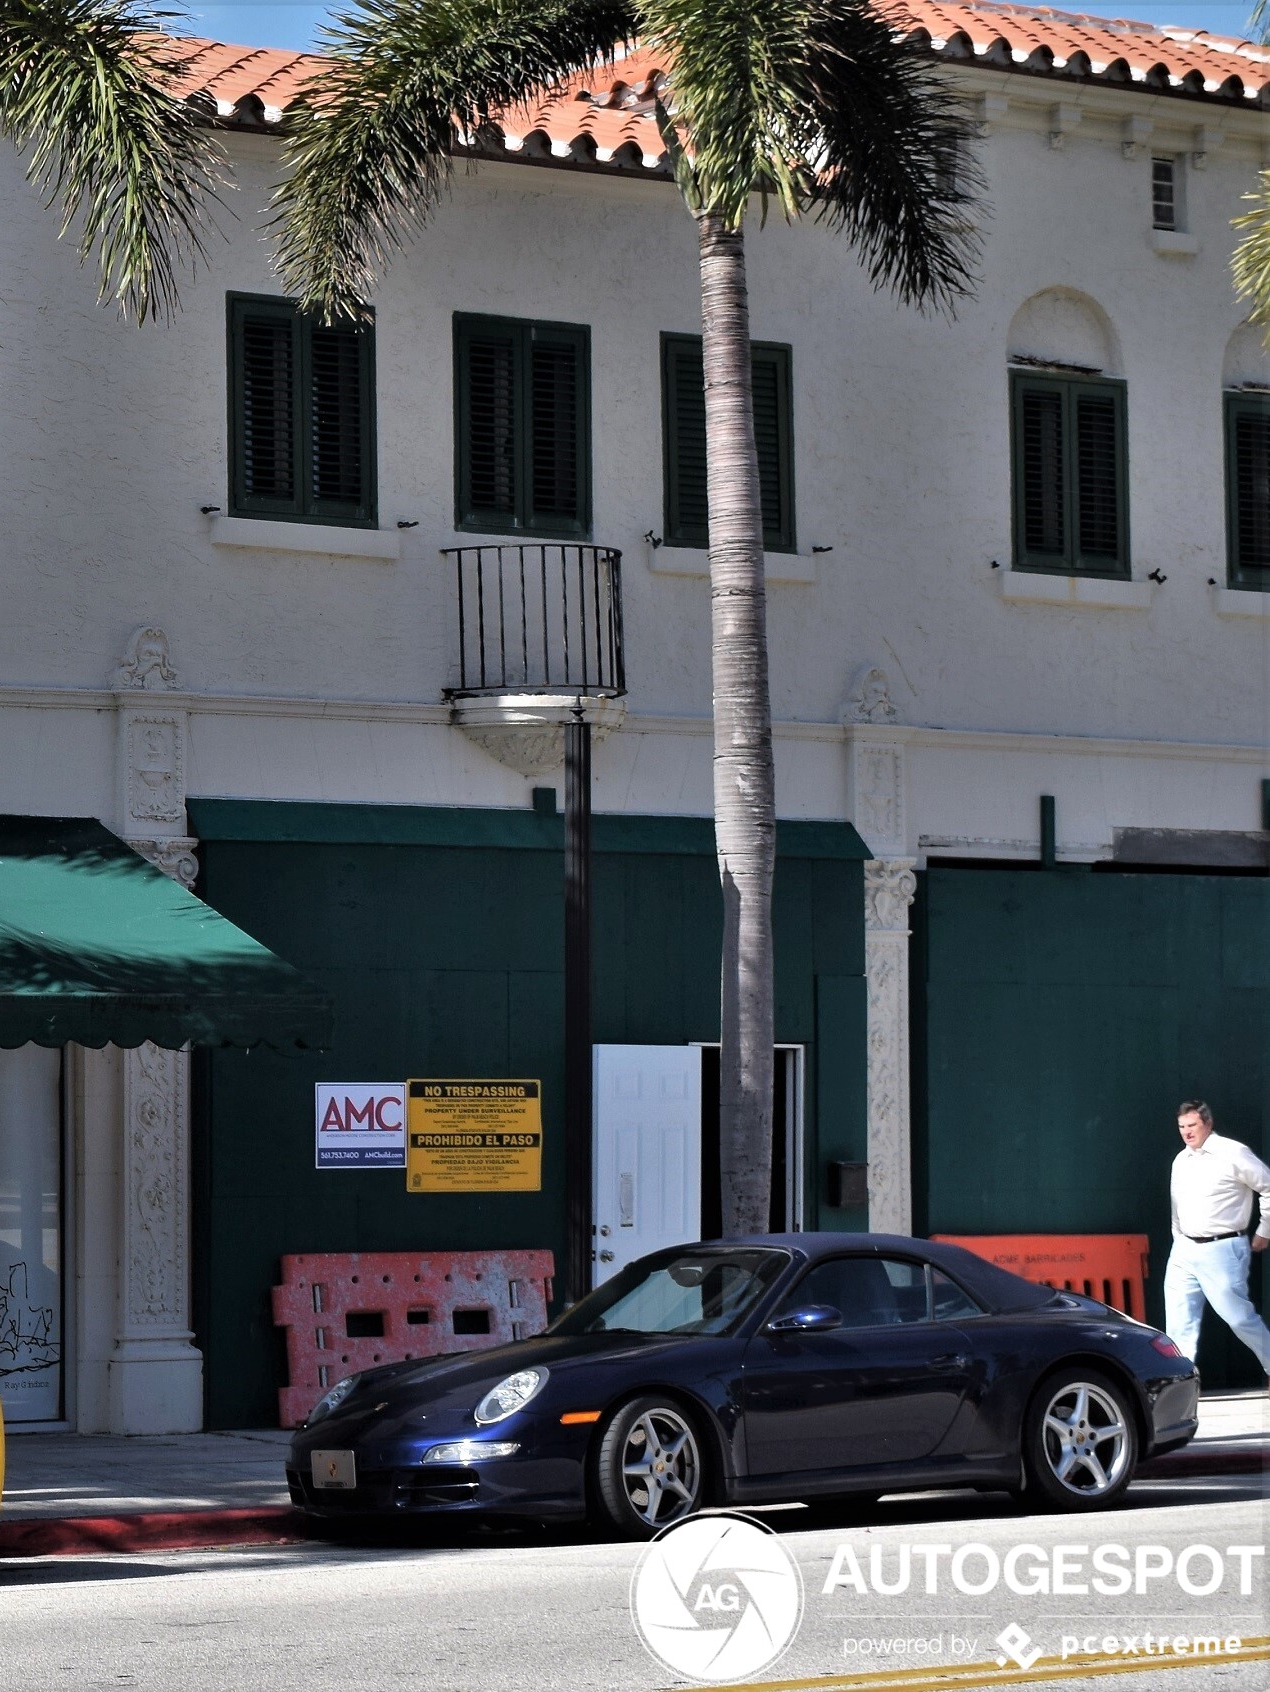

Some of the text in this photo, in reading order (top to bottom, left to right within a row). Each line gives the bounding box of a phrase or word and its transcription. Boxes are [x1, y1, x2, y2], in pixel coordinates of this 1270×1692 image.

[424, 1086, 526, 1097] NO TRESPASSING
[320, 1096, 403, 1131] AMC
[417, 1135, 534, 1145] PROHIBIDO EL PASO
[364, 1151, 403, 1159] AMCbuild.com
[993, 1253, 1086, 1264] ACME BARRICADES
